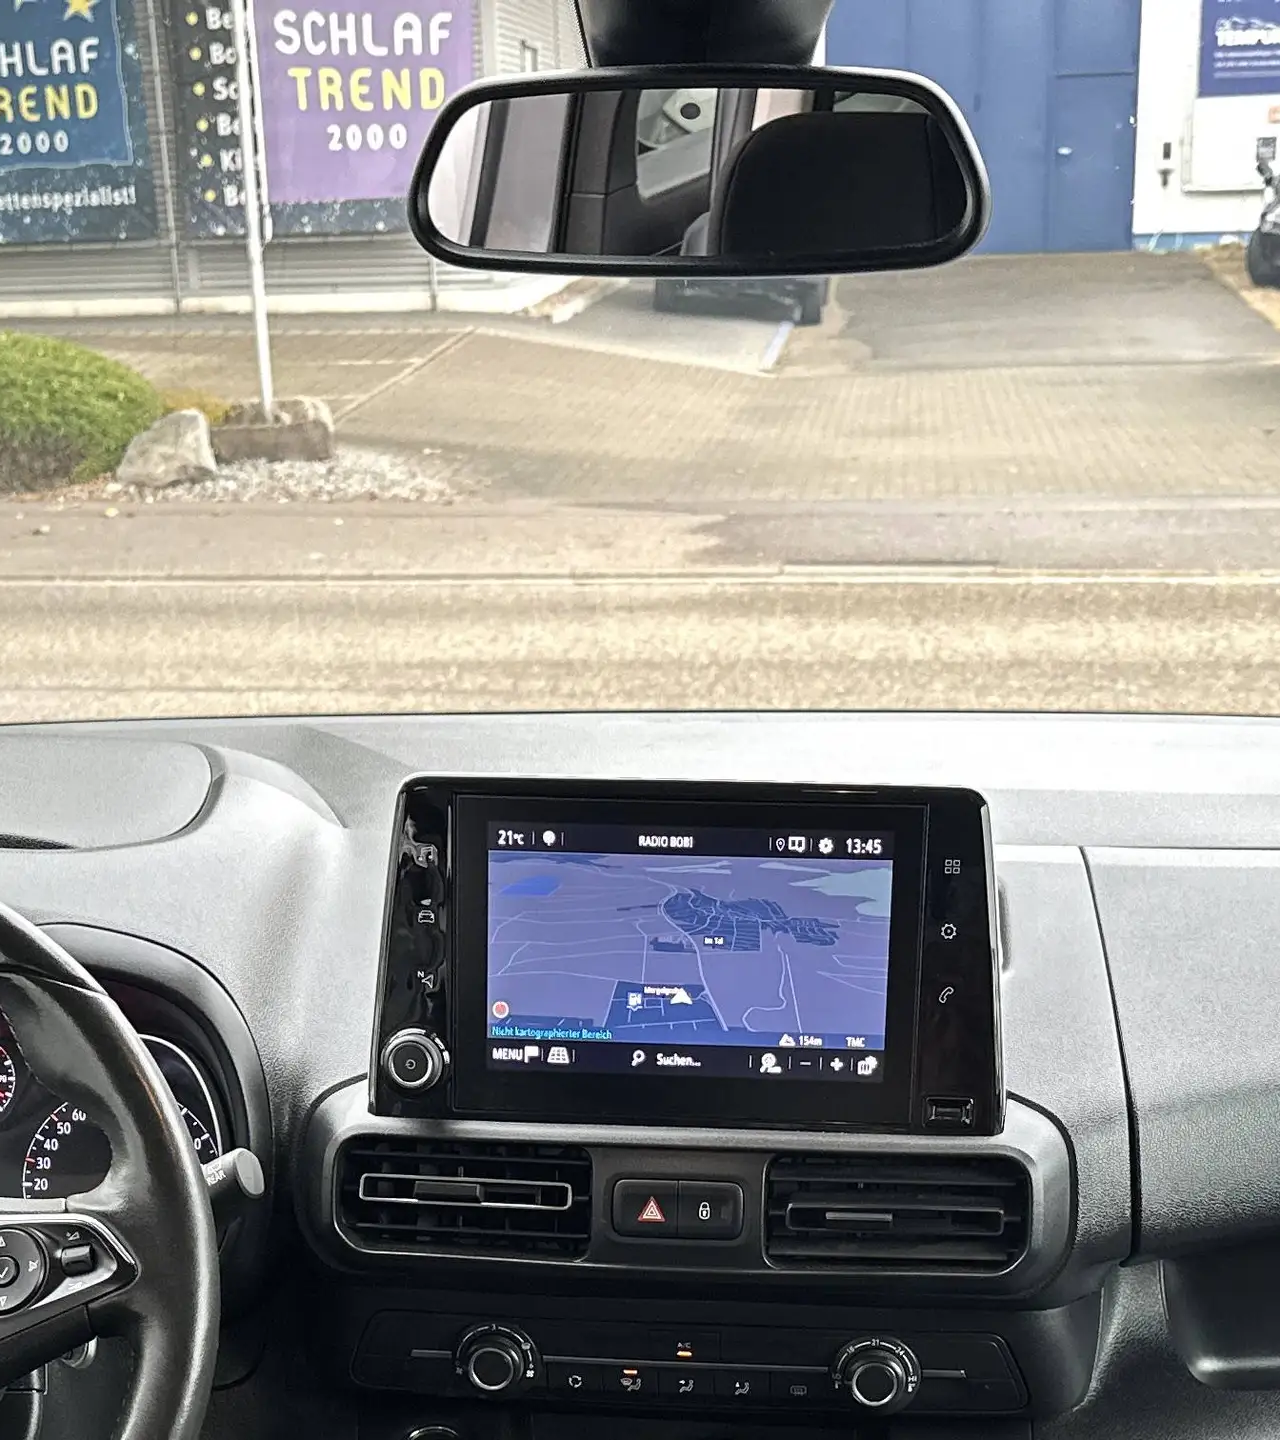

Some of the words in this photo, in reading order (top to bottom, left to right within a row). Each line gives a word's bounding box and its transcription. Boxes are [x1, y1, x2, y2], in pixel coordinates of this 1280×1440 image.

[273, 10, 453, 57] SCHLAF
[287, 66, 445, 111] TREND
[326, 123, 408, 151] 2000
[638, 835, 668, 847] RADIO
[845, 837, 882, 854] 13:45
[491, 1026, 513, 1037] Nicht
[582, 1029, 613, 1040] Bereich
[798, 1035, 823, 1047] 154m
[845, 1036, 866, 1048] TMC
[491, 1046, 523, 1061] MENU
[57, 1122, 71, 1135] 50
[43, 1137, 58, 1151] 40
[37, 1157, 52, 1170] 30
[34, 1178, 49, 1191] 20
